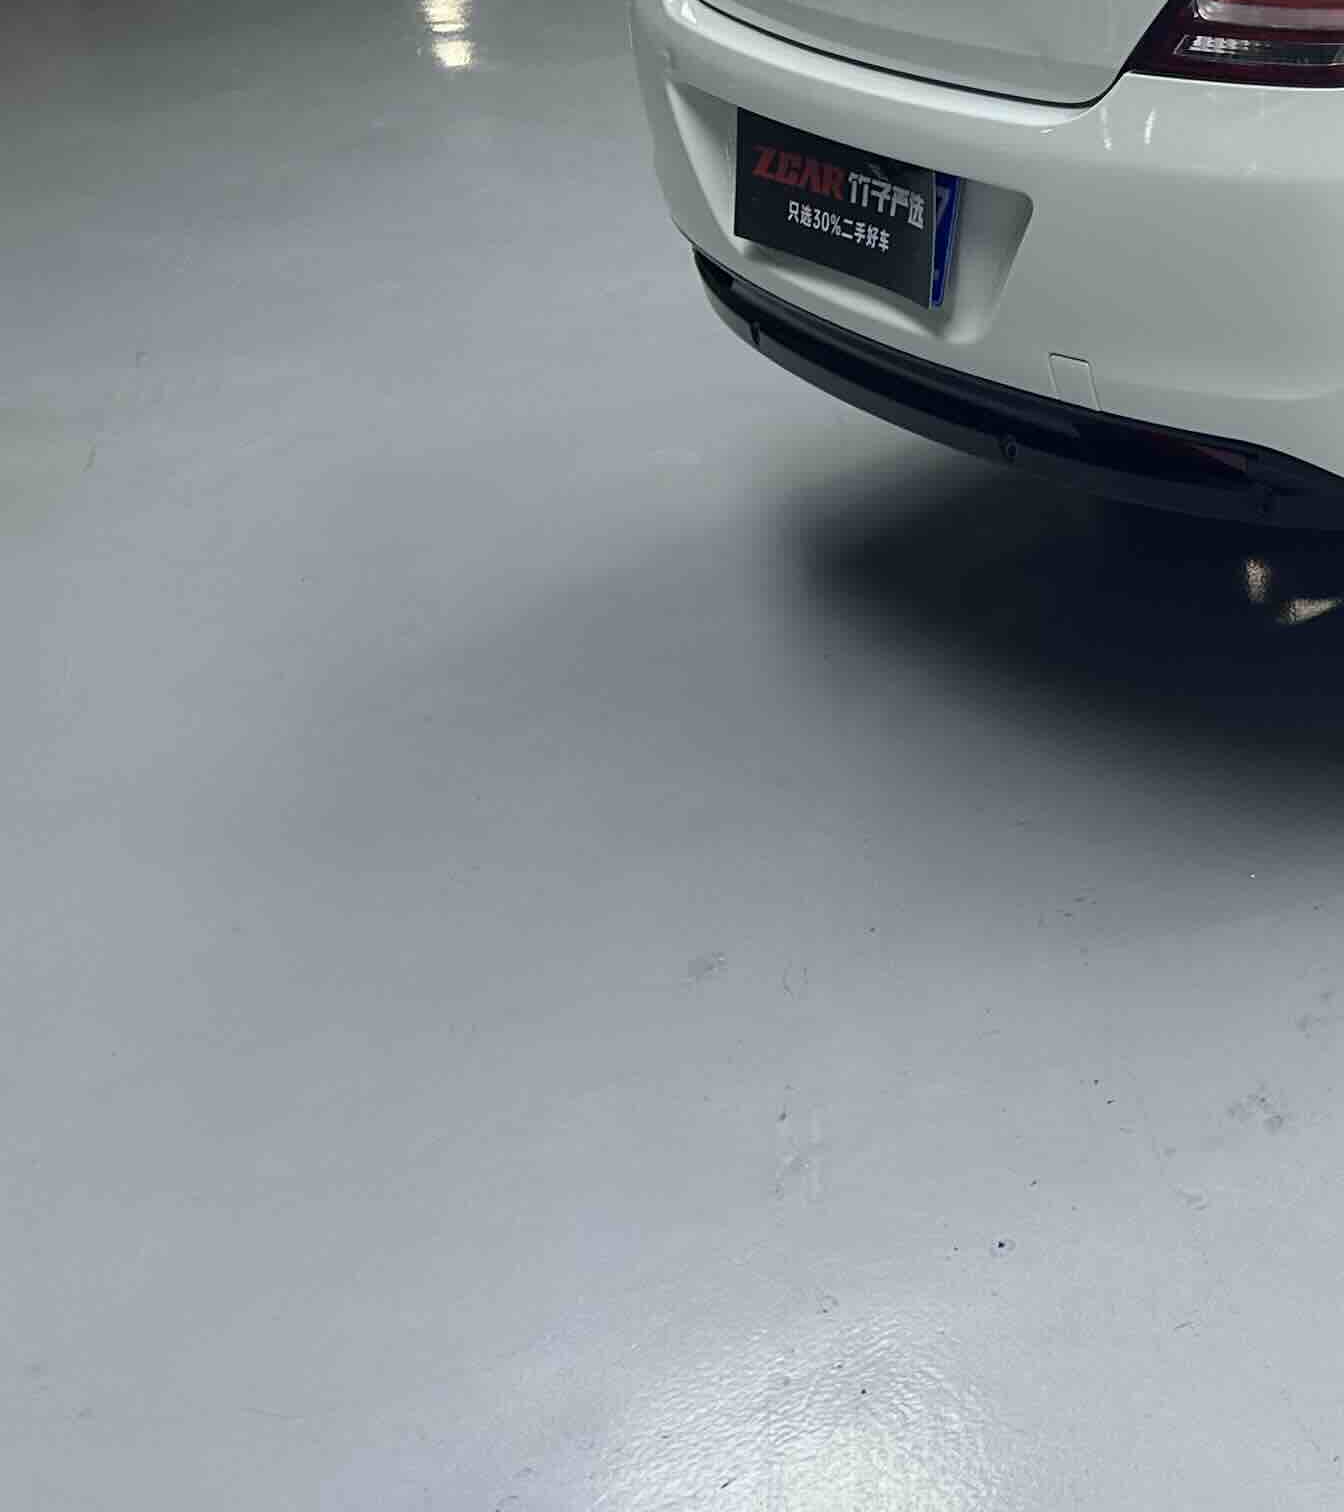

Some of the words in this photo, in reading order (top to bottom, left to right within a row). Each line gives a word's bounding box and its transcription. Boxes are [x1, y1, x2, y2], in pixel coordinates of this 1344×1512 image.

[787, 199, 890, 254] 只选30%二手好车
[848, 171, 926, 231] 竹子严选
